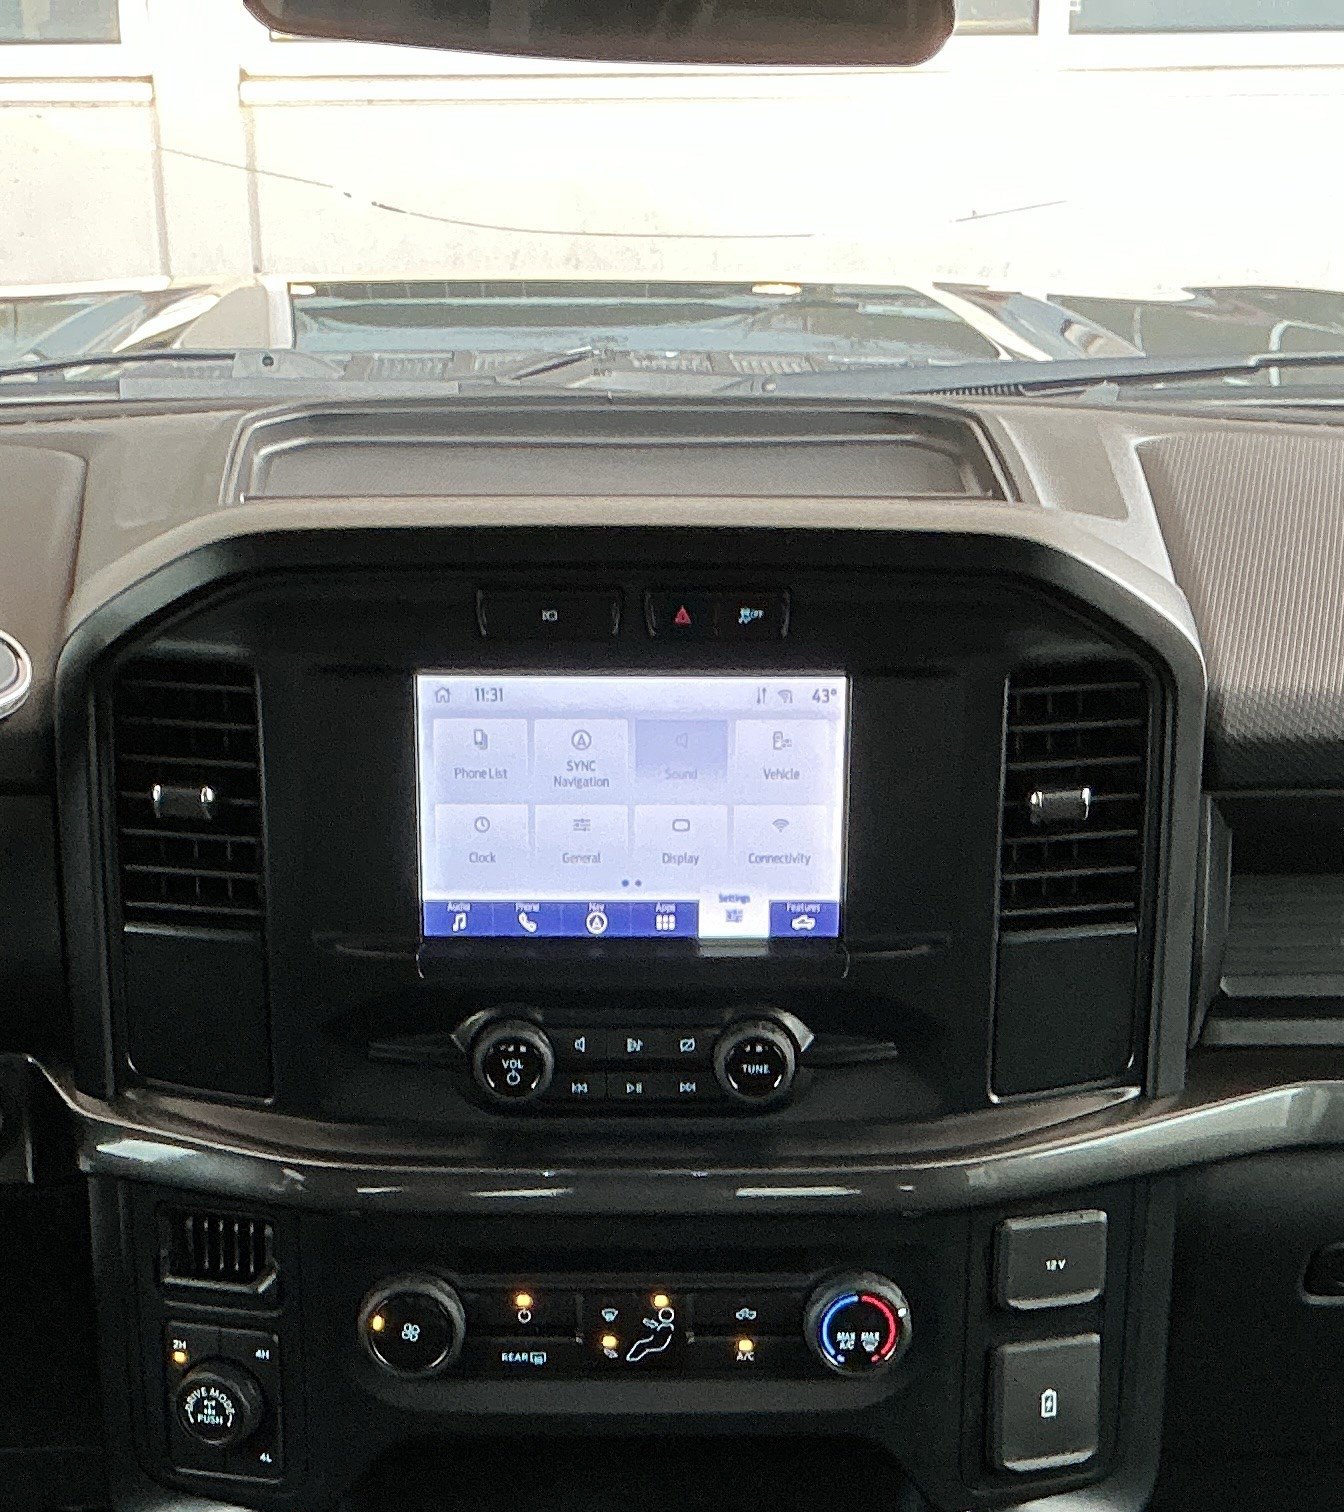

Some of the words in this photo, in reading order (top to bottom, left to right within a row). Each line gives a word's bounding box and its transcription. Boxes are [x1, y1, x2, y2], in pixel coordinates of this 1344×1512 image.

[475, 687, 504, 702] 11:31
[566, 760, 596, 772] SYNC
[454, 768, 487, 780] Phone
[489, 768, 508, 780] List
[763, 767, 800, 780] Vehicle
[553, 776, 610, 789] Navigation
[468, 852, 497, 864] Clock
[562, 852, 601, 864] General
[661, 852, 700, 866] Display
[748, 852, 812, 866] Connectivity
[501, 1058, 524, 1070] VOL
[742, 1063, 771, 1075] TUNE
[172, 1339, 187, 1350] 2H
[501, 1351, 529, 1362] REAR
[736, 1352, 755, 1362] A/C
